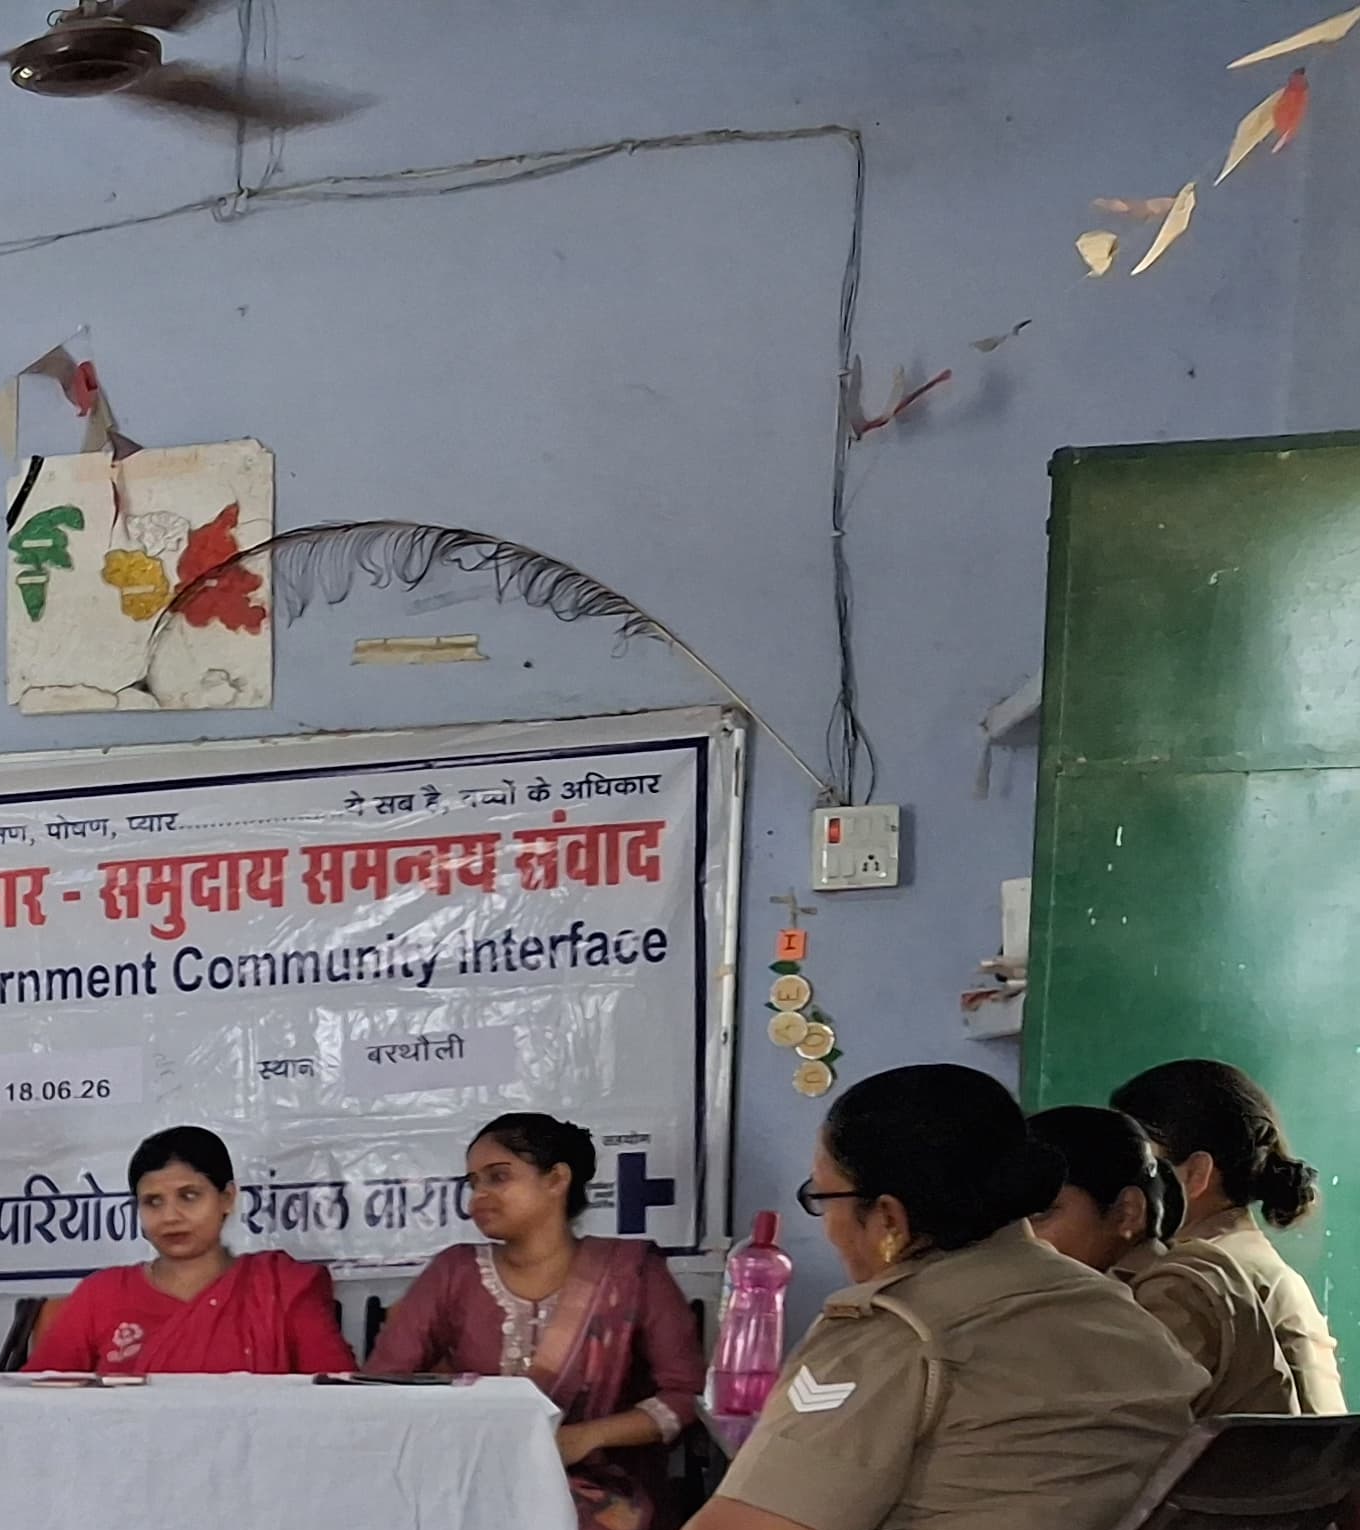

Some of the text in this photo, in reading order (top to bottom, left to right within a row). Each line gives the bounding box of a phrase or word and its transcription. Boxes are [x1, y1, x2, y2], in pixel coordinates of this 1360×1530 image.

[45, 814, 117, 841] पोषण,
[372, 789, 415, 816] सब
[528, 776, 551, 803] के
[561, 771, 662, 799] अधिकार
[62, 890, 81, 902] -
[97, 847, 288, 940] समुदाय
[301, 832, 501, 906] समन्वय
[512, 808, 666, 890] संवाद
[172, 932, 440, 992] Community
[458, 920, 668, 975] Interface
[367, 1031, 465, 1066] बरथौली
[5, 1078, 110, 1101] 18.06.26
